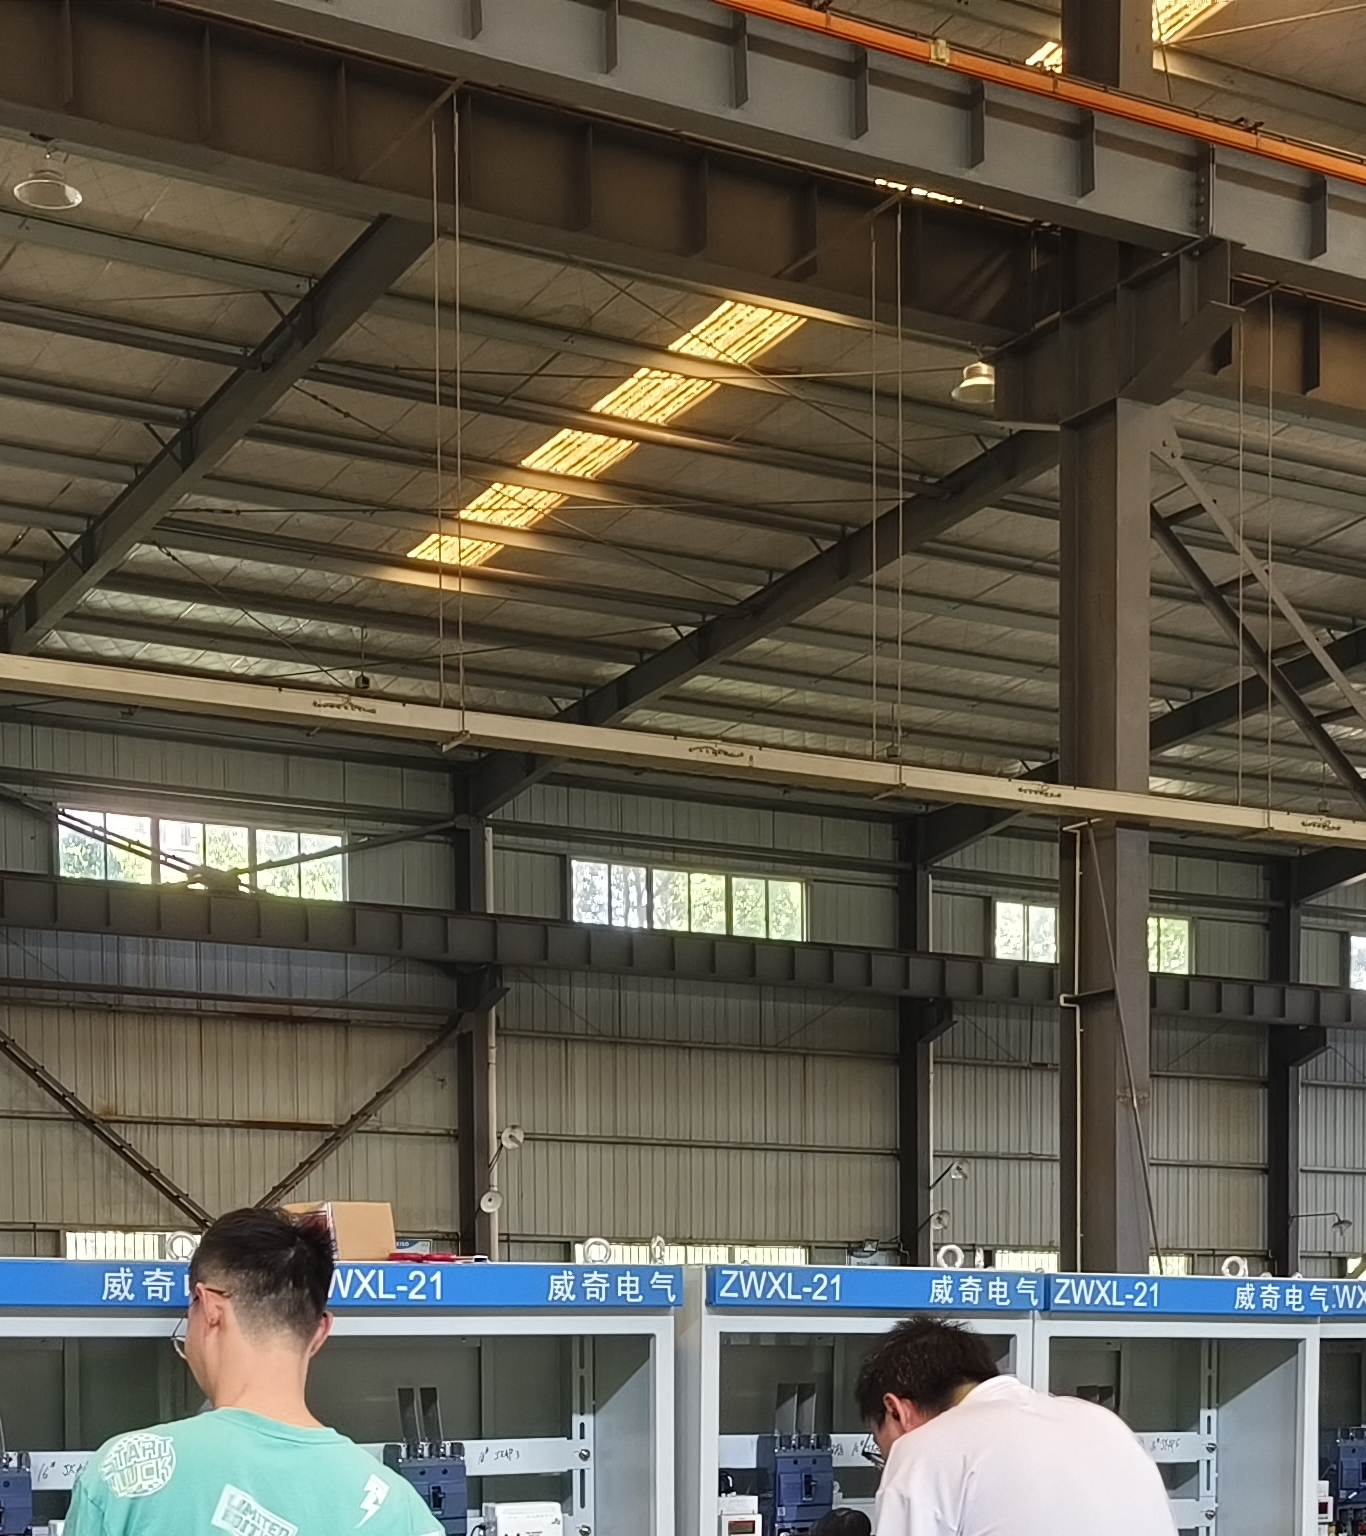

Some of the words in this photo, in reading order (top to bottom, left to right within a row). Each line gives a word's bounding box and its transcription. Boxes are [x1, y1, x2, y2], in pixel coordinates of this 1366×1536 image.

[102, 1267, 190, 1302] 威奇
[547, 1270, 676, 1303] 威奇电气
[719, 1271, 842, 1301] ZWXL-21
[929, 1275, 1039, 1307] 威奇电气
[1053, 1278, 1160, 1307] ZWXL-21
[1234, 1284, 1329, 1313] 威奇电气
